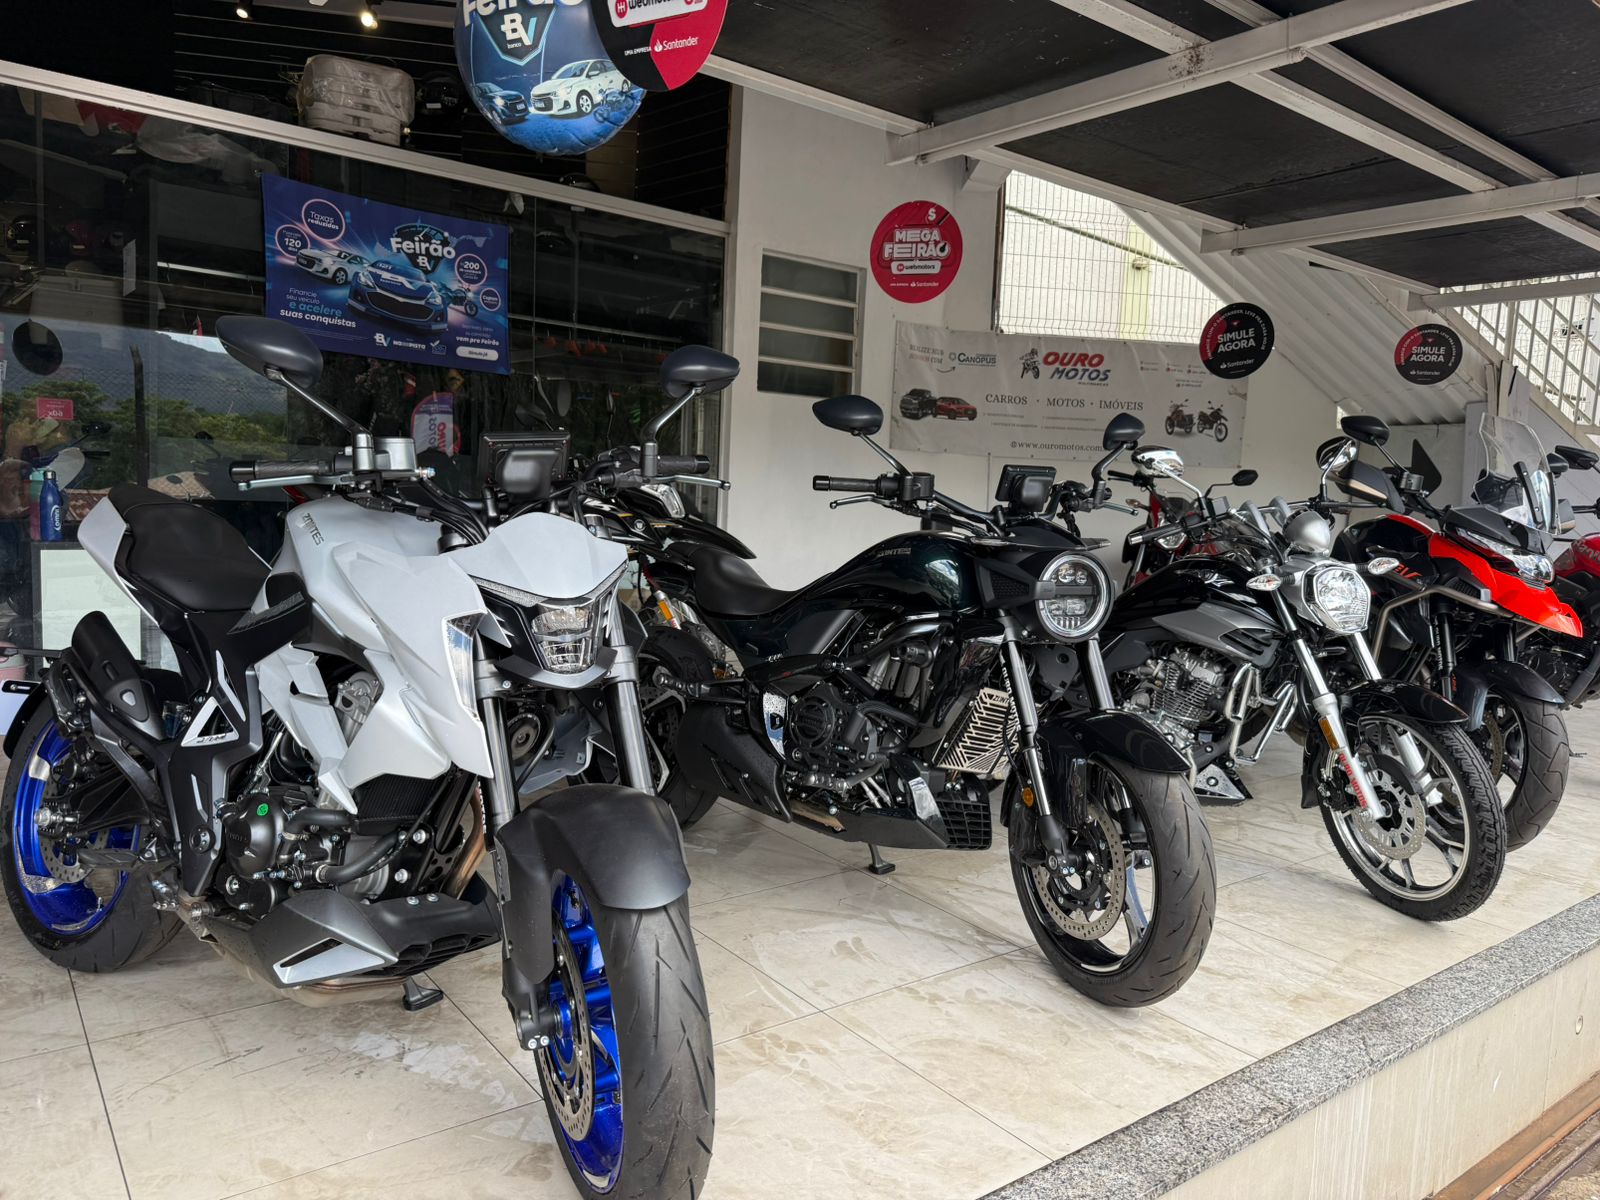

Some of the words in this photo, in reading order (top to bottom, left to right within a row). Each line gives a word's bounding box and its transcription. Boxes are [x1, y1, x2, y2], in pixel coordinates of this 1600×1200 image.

[662, 36, 699, 51] Santander
[307, 218, 340, 231] reduzidas
[310, 210, 334, 224] Taxas
[284, 237, 302, 249] 120
[895, 229, 940, 242] MEGA
[390, 236, 456, 259] Feirão
[884, 241, 949, 258] FEIRÃO
[463, 261, 480, 270] 200
[289, 287, 318, 298] Financie
[289, 301, 297, 309] e
[298, 303, 342, 317] acelere
[280, 309, 304, 319] suas
[304, 313, 357, 328] conquistas
[1217, 327, 1255, 343] SIMULE
[1217, 338, 1256, 353] AGORA
[1411, 346, 1446, 355] SIMULE
[1042, 351, 1105, 368] OURO
[1227, 358, 1255, 368] Santander
[1409, 354, 1445, 363] AGORA
[1049, 367, 1112, 382] MOTOS
[985, 393, 1028, 405] CARROS
[1046, 398, 1085, 408] MOTOS
[1099, 398, 1144, 411] IMÓVEIS
